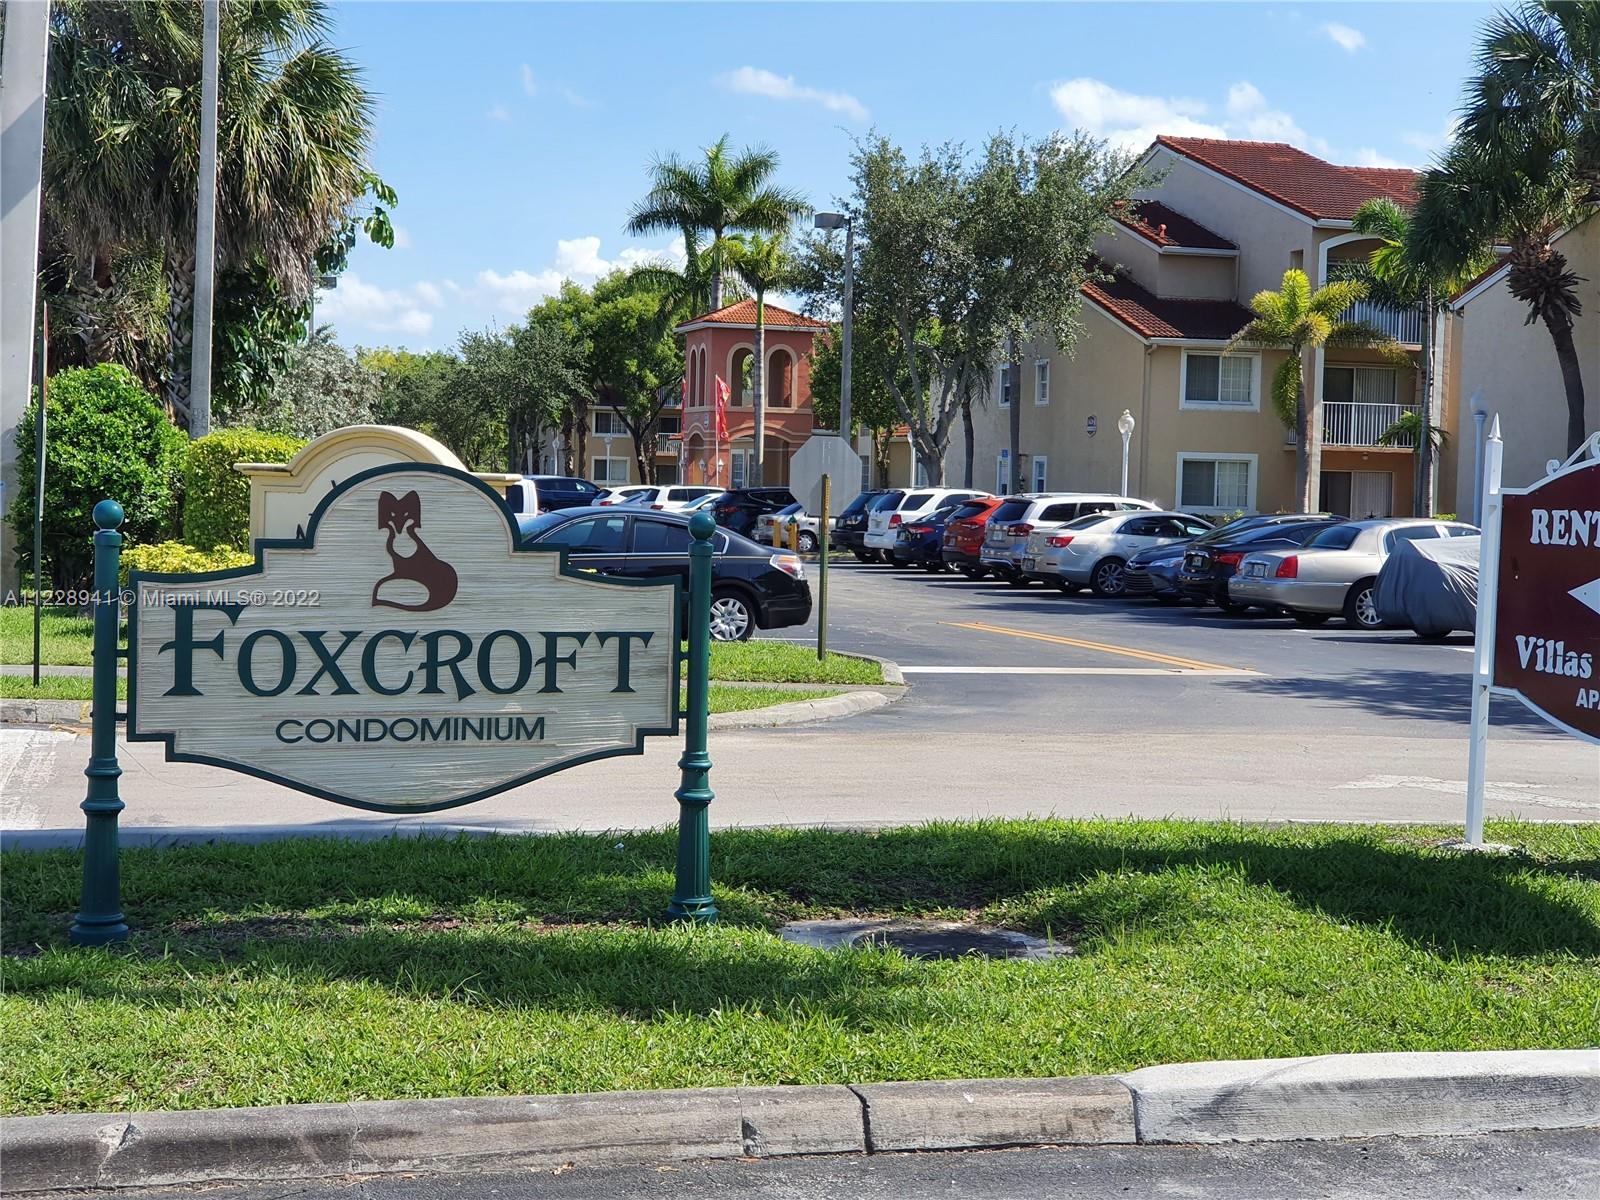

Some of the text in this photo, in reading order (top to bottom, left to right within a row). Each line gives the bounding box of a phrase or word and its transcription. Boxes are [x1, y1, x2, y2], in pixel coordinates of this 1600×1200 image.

[158, 604, 654, 701] FOXCROFT
[1515, 635, 1593, 679] Villas
[1576, 687, 1600, 710] AP
[276, 716, 544, 744] CONDOMINIUM
